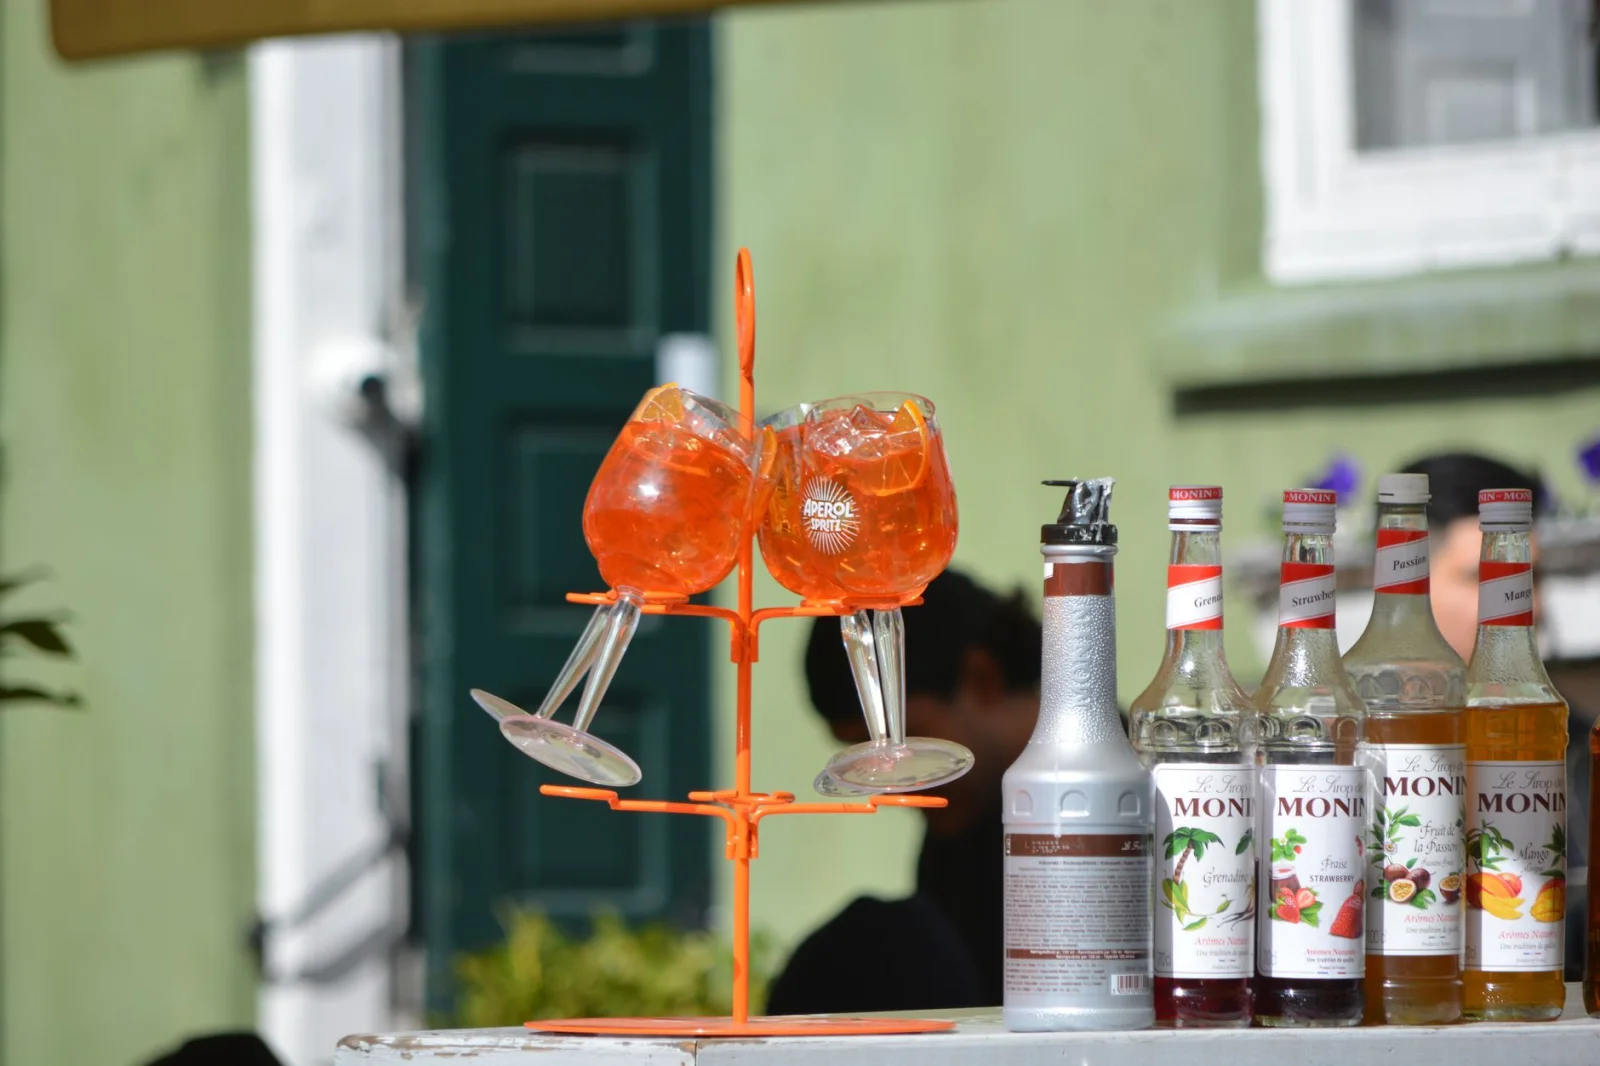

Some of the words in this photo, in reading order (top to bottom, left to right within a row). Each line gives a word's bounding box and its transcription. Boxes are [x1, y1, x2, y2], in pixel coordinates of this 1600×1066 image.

[1172, 489, 1213, 500] MONIN
[1288, 492, 1332, 502] MONIN
[803, 499, 855, 519] APEROL
[811, 518, 842, 532] SPRITZ
[1392, 556, 1427, 571] Passion
[1504, 588, 1532, 603] Mang
[1396, 754, 1422, 773] Le
[1424, 754, 1457, 776] Sirop
[1188, 775, 1214, 793] Le
[1292, 775, 1317, 793] Le
[1319, 775, 1353, 797] Sirop
[1492, 771, 1516, 789] Le
[1519, 771, 1553, 793] Sirop
[1173, 797, 1255, 818] MONI
[1420, 820, 1446, 839] Fruit
[1414, 839, 1424, 853] la
[1424, 837, 1458, 855] Passion
[1513, 842, 1549, 864] Mango
[1321, 855, 1348, 871] Fraise
[1202, 867, 1249, 888] Grenadine
[1309, 874, 1355, 883] STRAWBERRY
